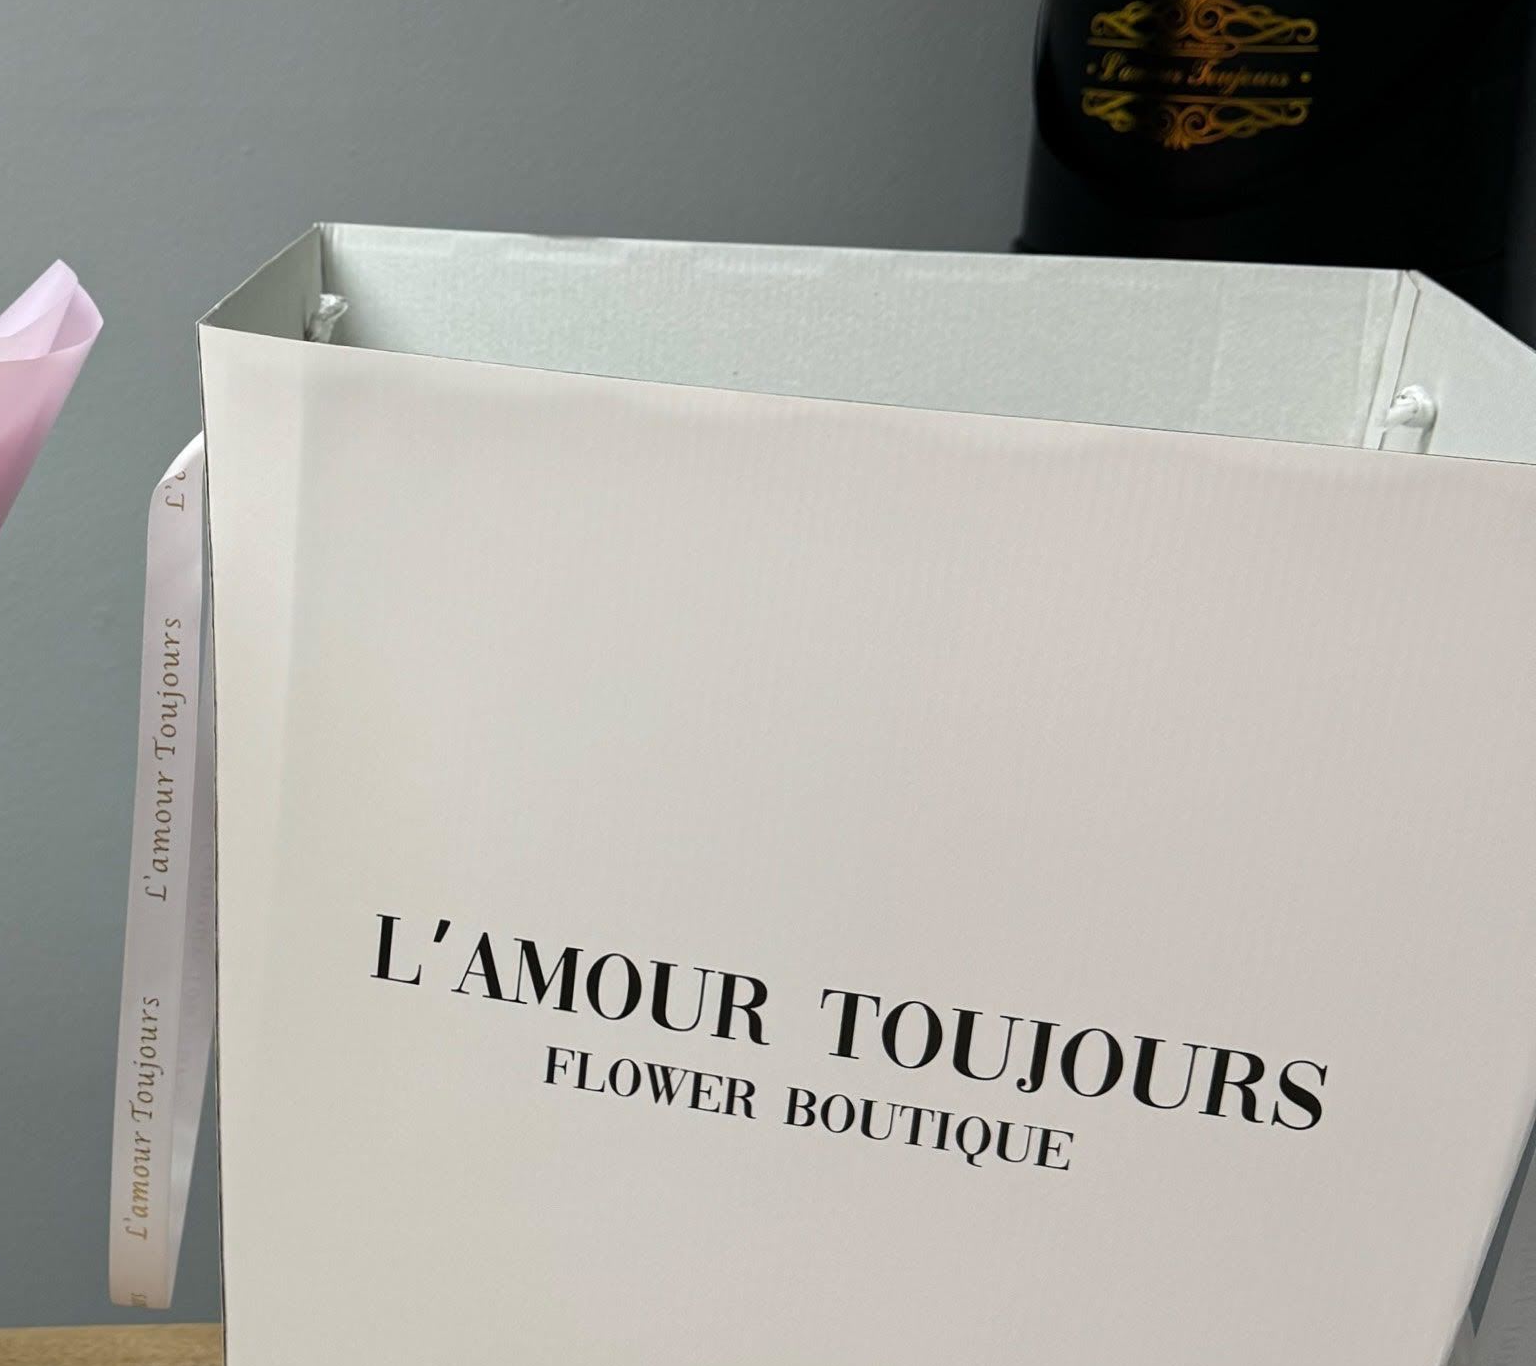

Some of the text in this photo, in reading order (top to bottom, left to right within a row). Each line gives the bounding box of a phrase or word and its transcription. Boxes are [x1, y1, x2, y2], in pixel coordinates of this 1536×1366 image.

[145, 617, 187, 902] L'amour Toujours
[124, 995, 165, 1241] L'amour Toujours
[371, 913, 770, 1047] L'AMOUR
[819, 986, 1331, 1132] TOUJOURS
[542, 1046, 1076, 1171] FLOWER BOUTIQUE
